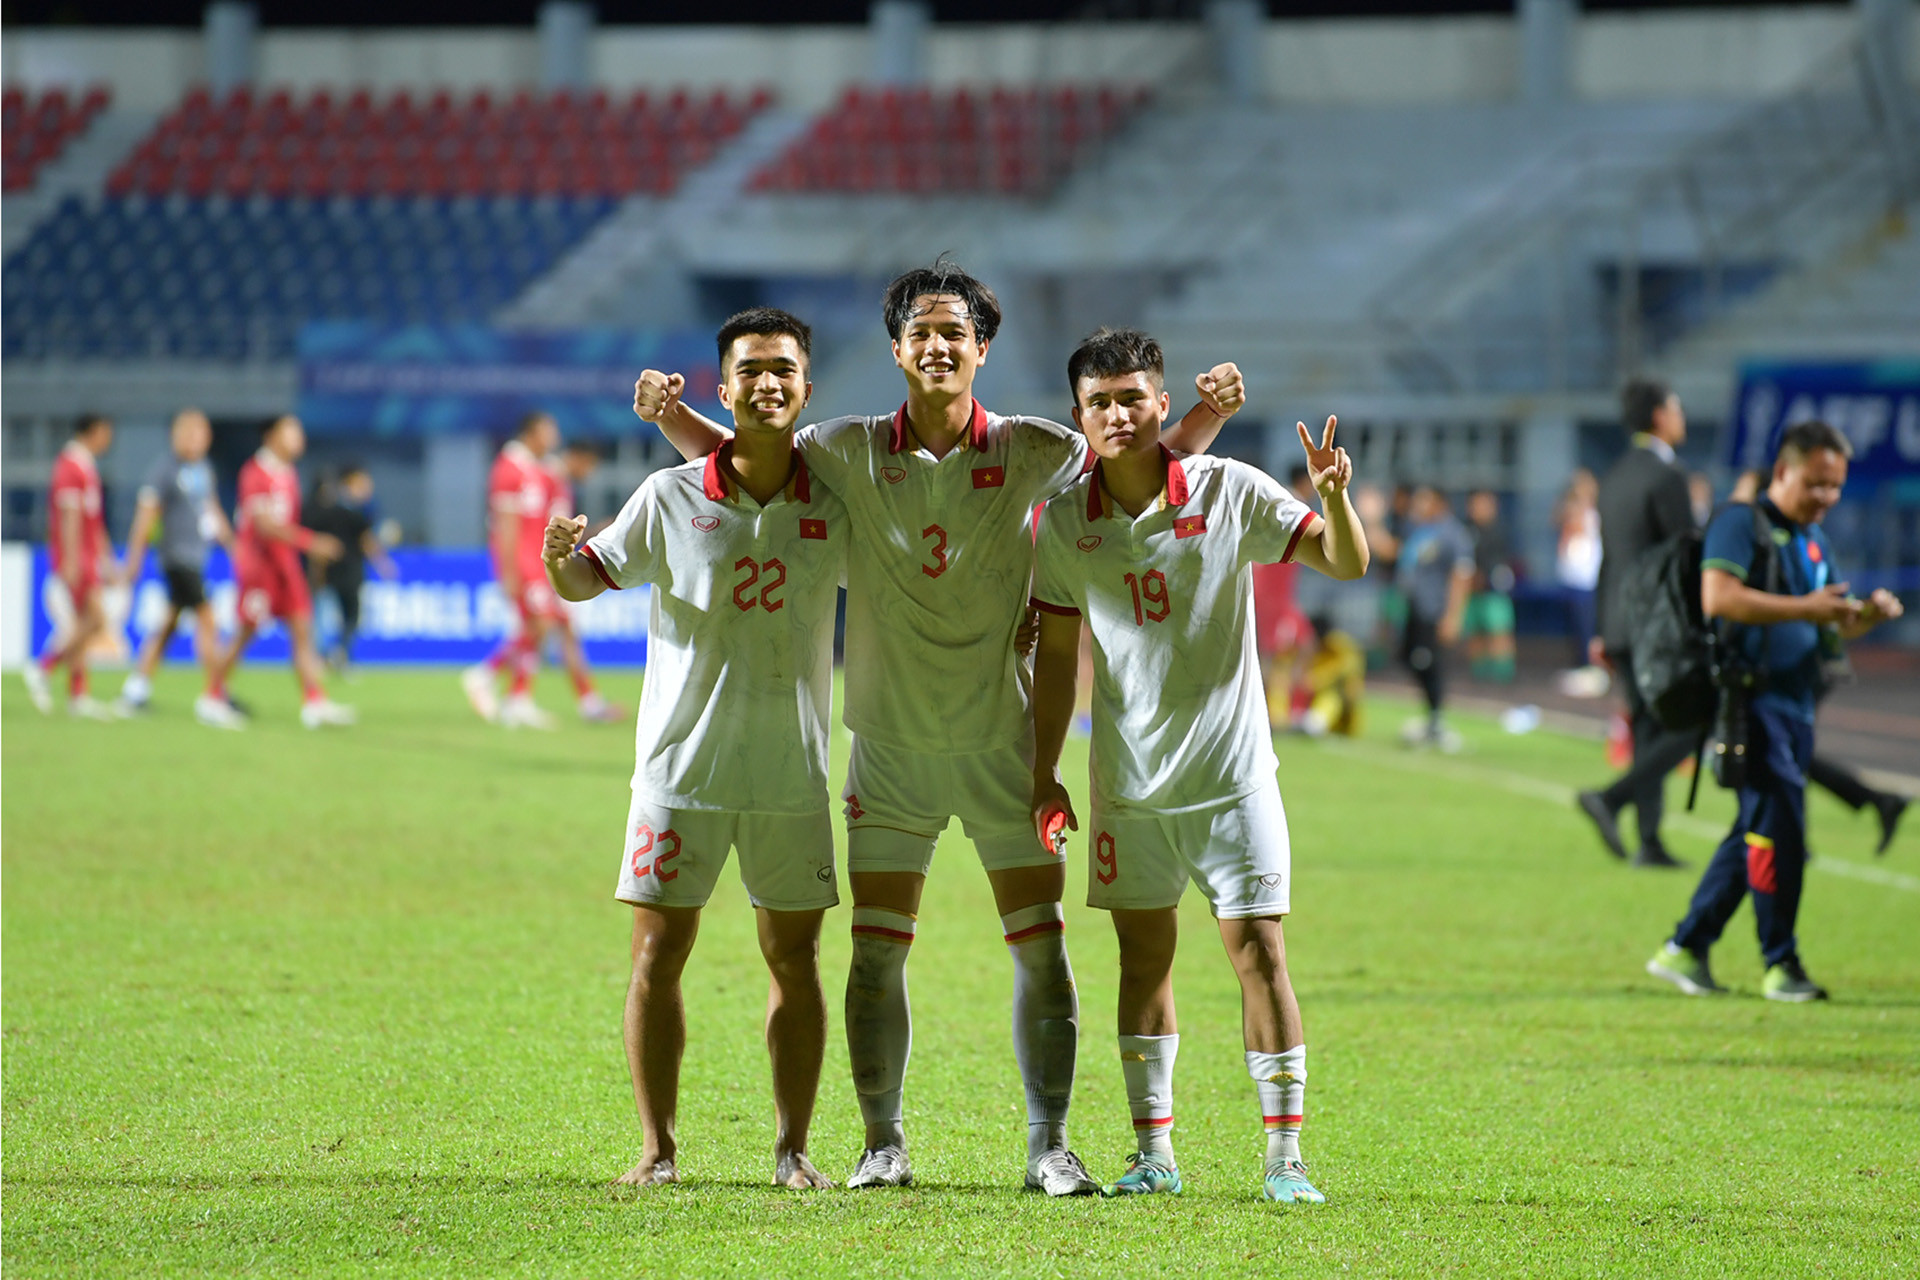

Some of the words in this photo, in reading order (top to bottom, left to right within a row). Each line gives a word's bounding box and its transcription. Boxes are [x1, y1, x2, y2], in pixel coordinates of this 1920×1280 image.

[922, 523, 947, 579] 3
[733, 555, 787, 613] 22
[1123, 568, 1171, 626] 19
[631, 824, 682, 883] 22
[1093, 830, 1118, 885] 9
